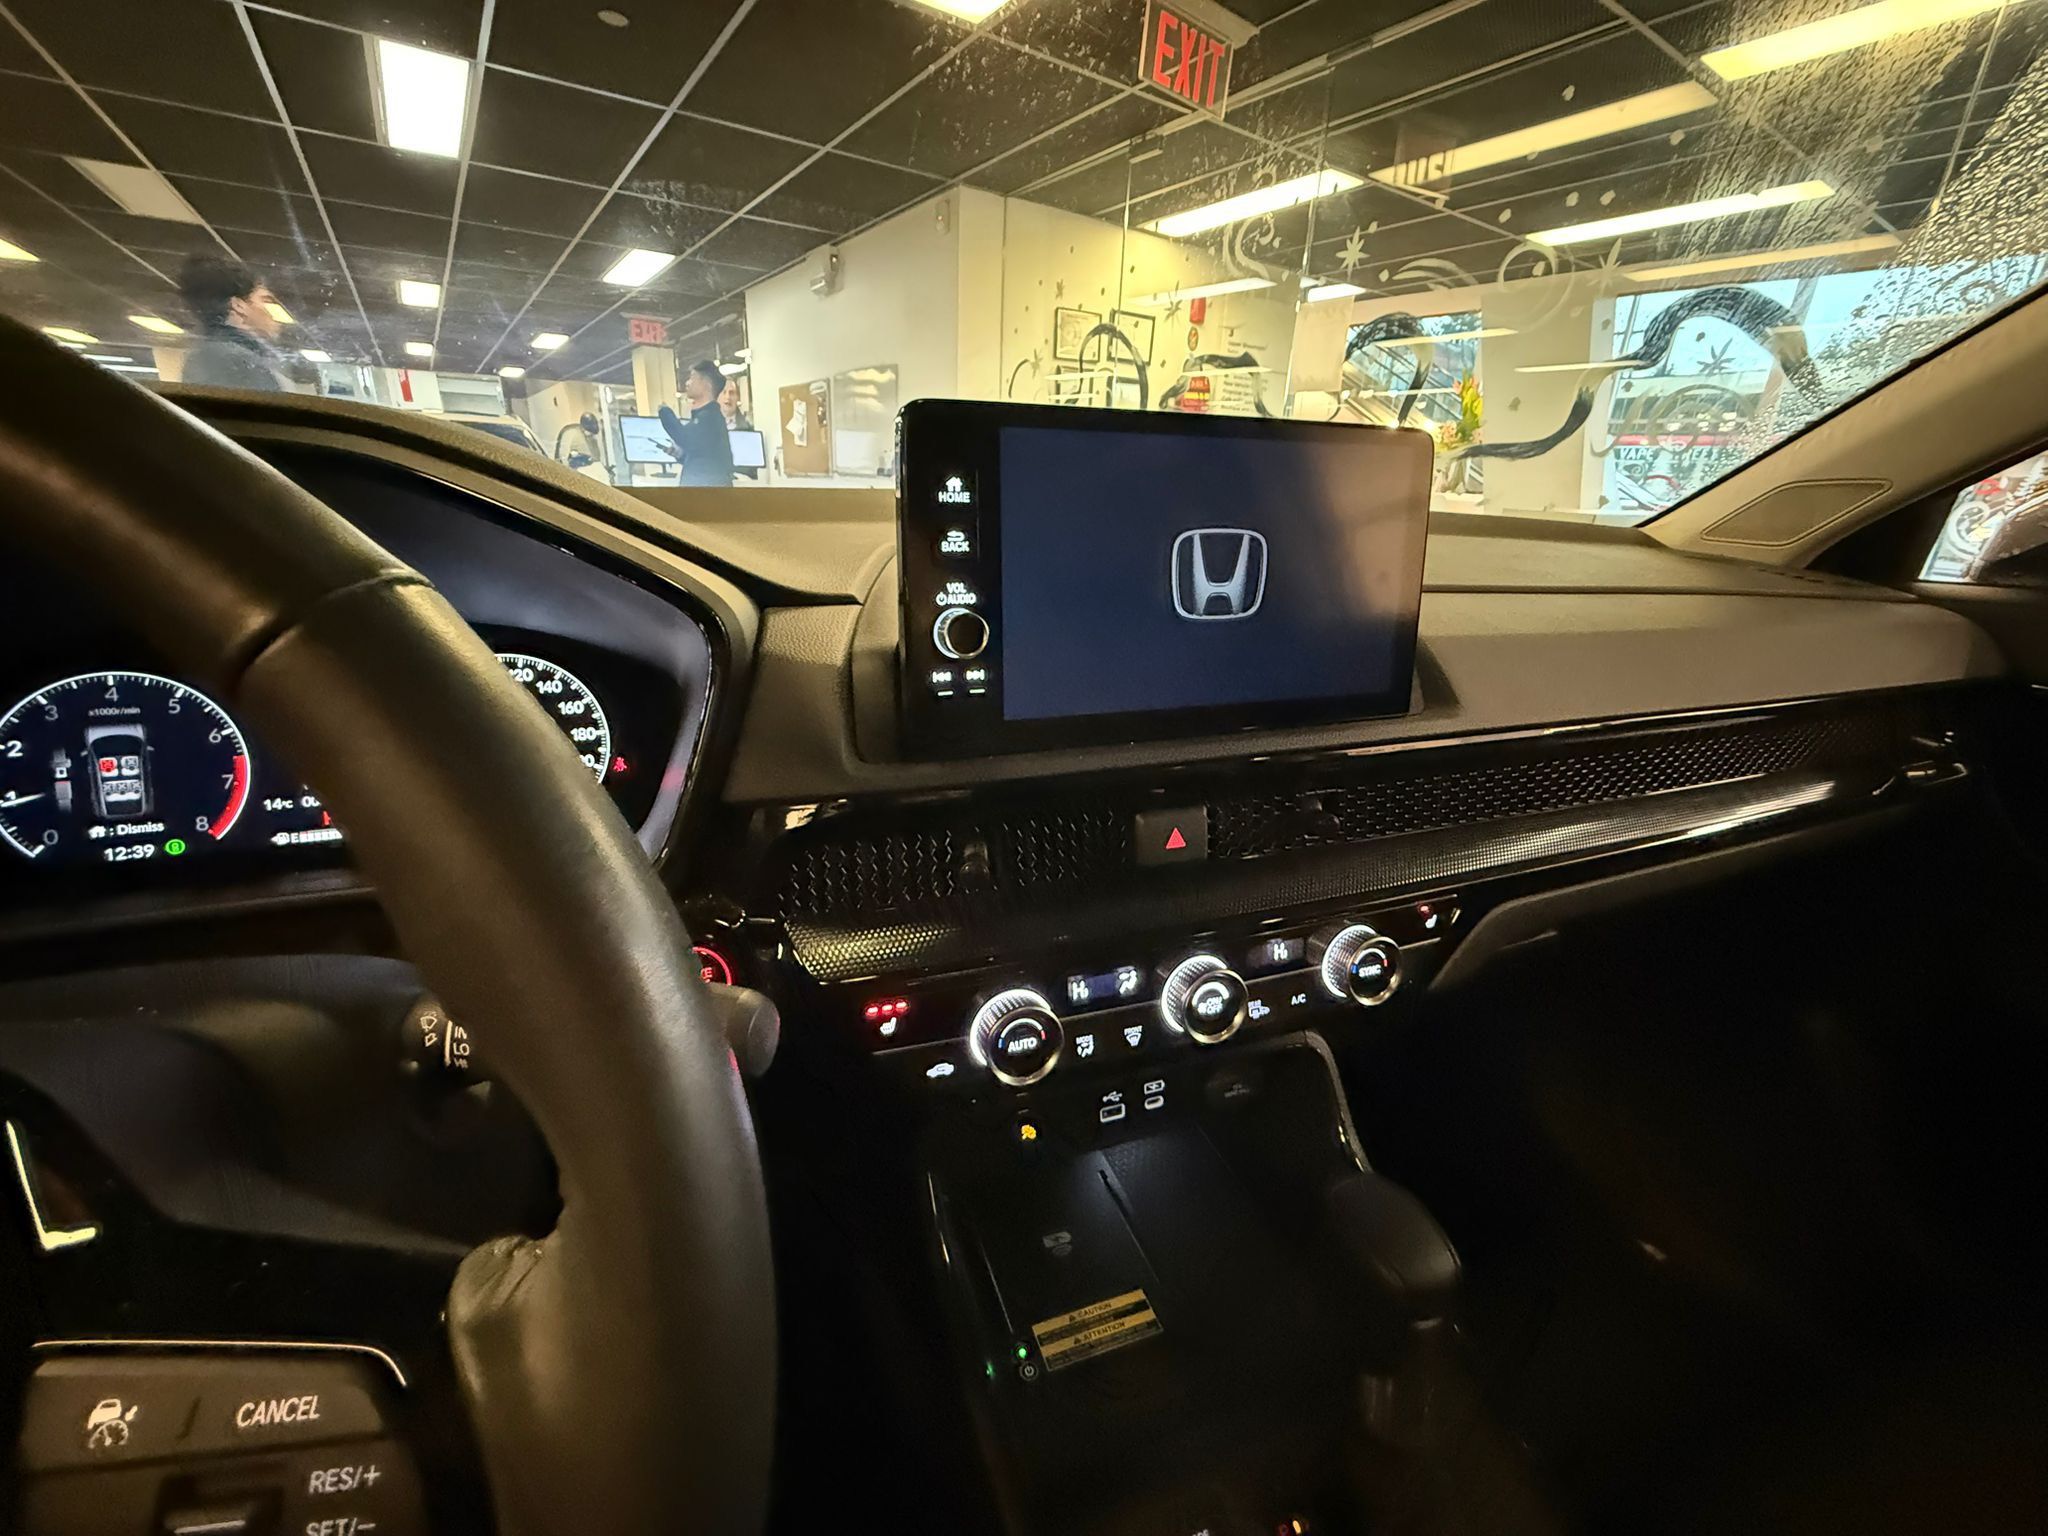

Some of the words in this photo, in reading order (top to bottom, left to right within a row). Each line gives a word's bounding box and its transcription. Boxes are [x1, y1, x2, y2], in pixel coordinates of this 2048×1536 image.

[1153, 10, 1225, 110] EXIT
[1619, 447, 1654, 461] VAPE
[938, 491, 970, 503] HOME
[941, 541, 969, 552] BACK
[946, 583, 966, 593] VOL
[947, 593, 976, 604] AUDIO
[105, 686, 119, 701] 4
[536, 680, 562, 694] 140
[45, 705, 58, 720] 3
[168, 699, 180, 714] 5
[558, 700, 584, 715] 160
[208, 728, 222, 743] 6
[570, 726, 597, 741] 180
[7, 740, 23, 757] 2
[221, 774, 234, 789] 7
[116, 822, 165, 836] Dismiss
[195, 816, 209, 831] 8
[43, 829, 59, 845] 0
[104, 844, 155, 862] 12:39
[1359, 964, 1381, 978] SYNC
[1291, 993, 1306, 1005] A/C
[1124, 1025, 1143, 1036] FRONT
[1008, 1037, 1038, 1053] AUTO
[1076, 1034, 1094, 1045] MODE
[453, 1042, 470, 1056] LO
[1078, 1303, 1112, 1317] CAUTION
[1083, 1320, 1126, 1341] ATTENTION
[236, 1395, 320, 1428] CANCEL
[309, 1465, 381, 1493] RES/+
